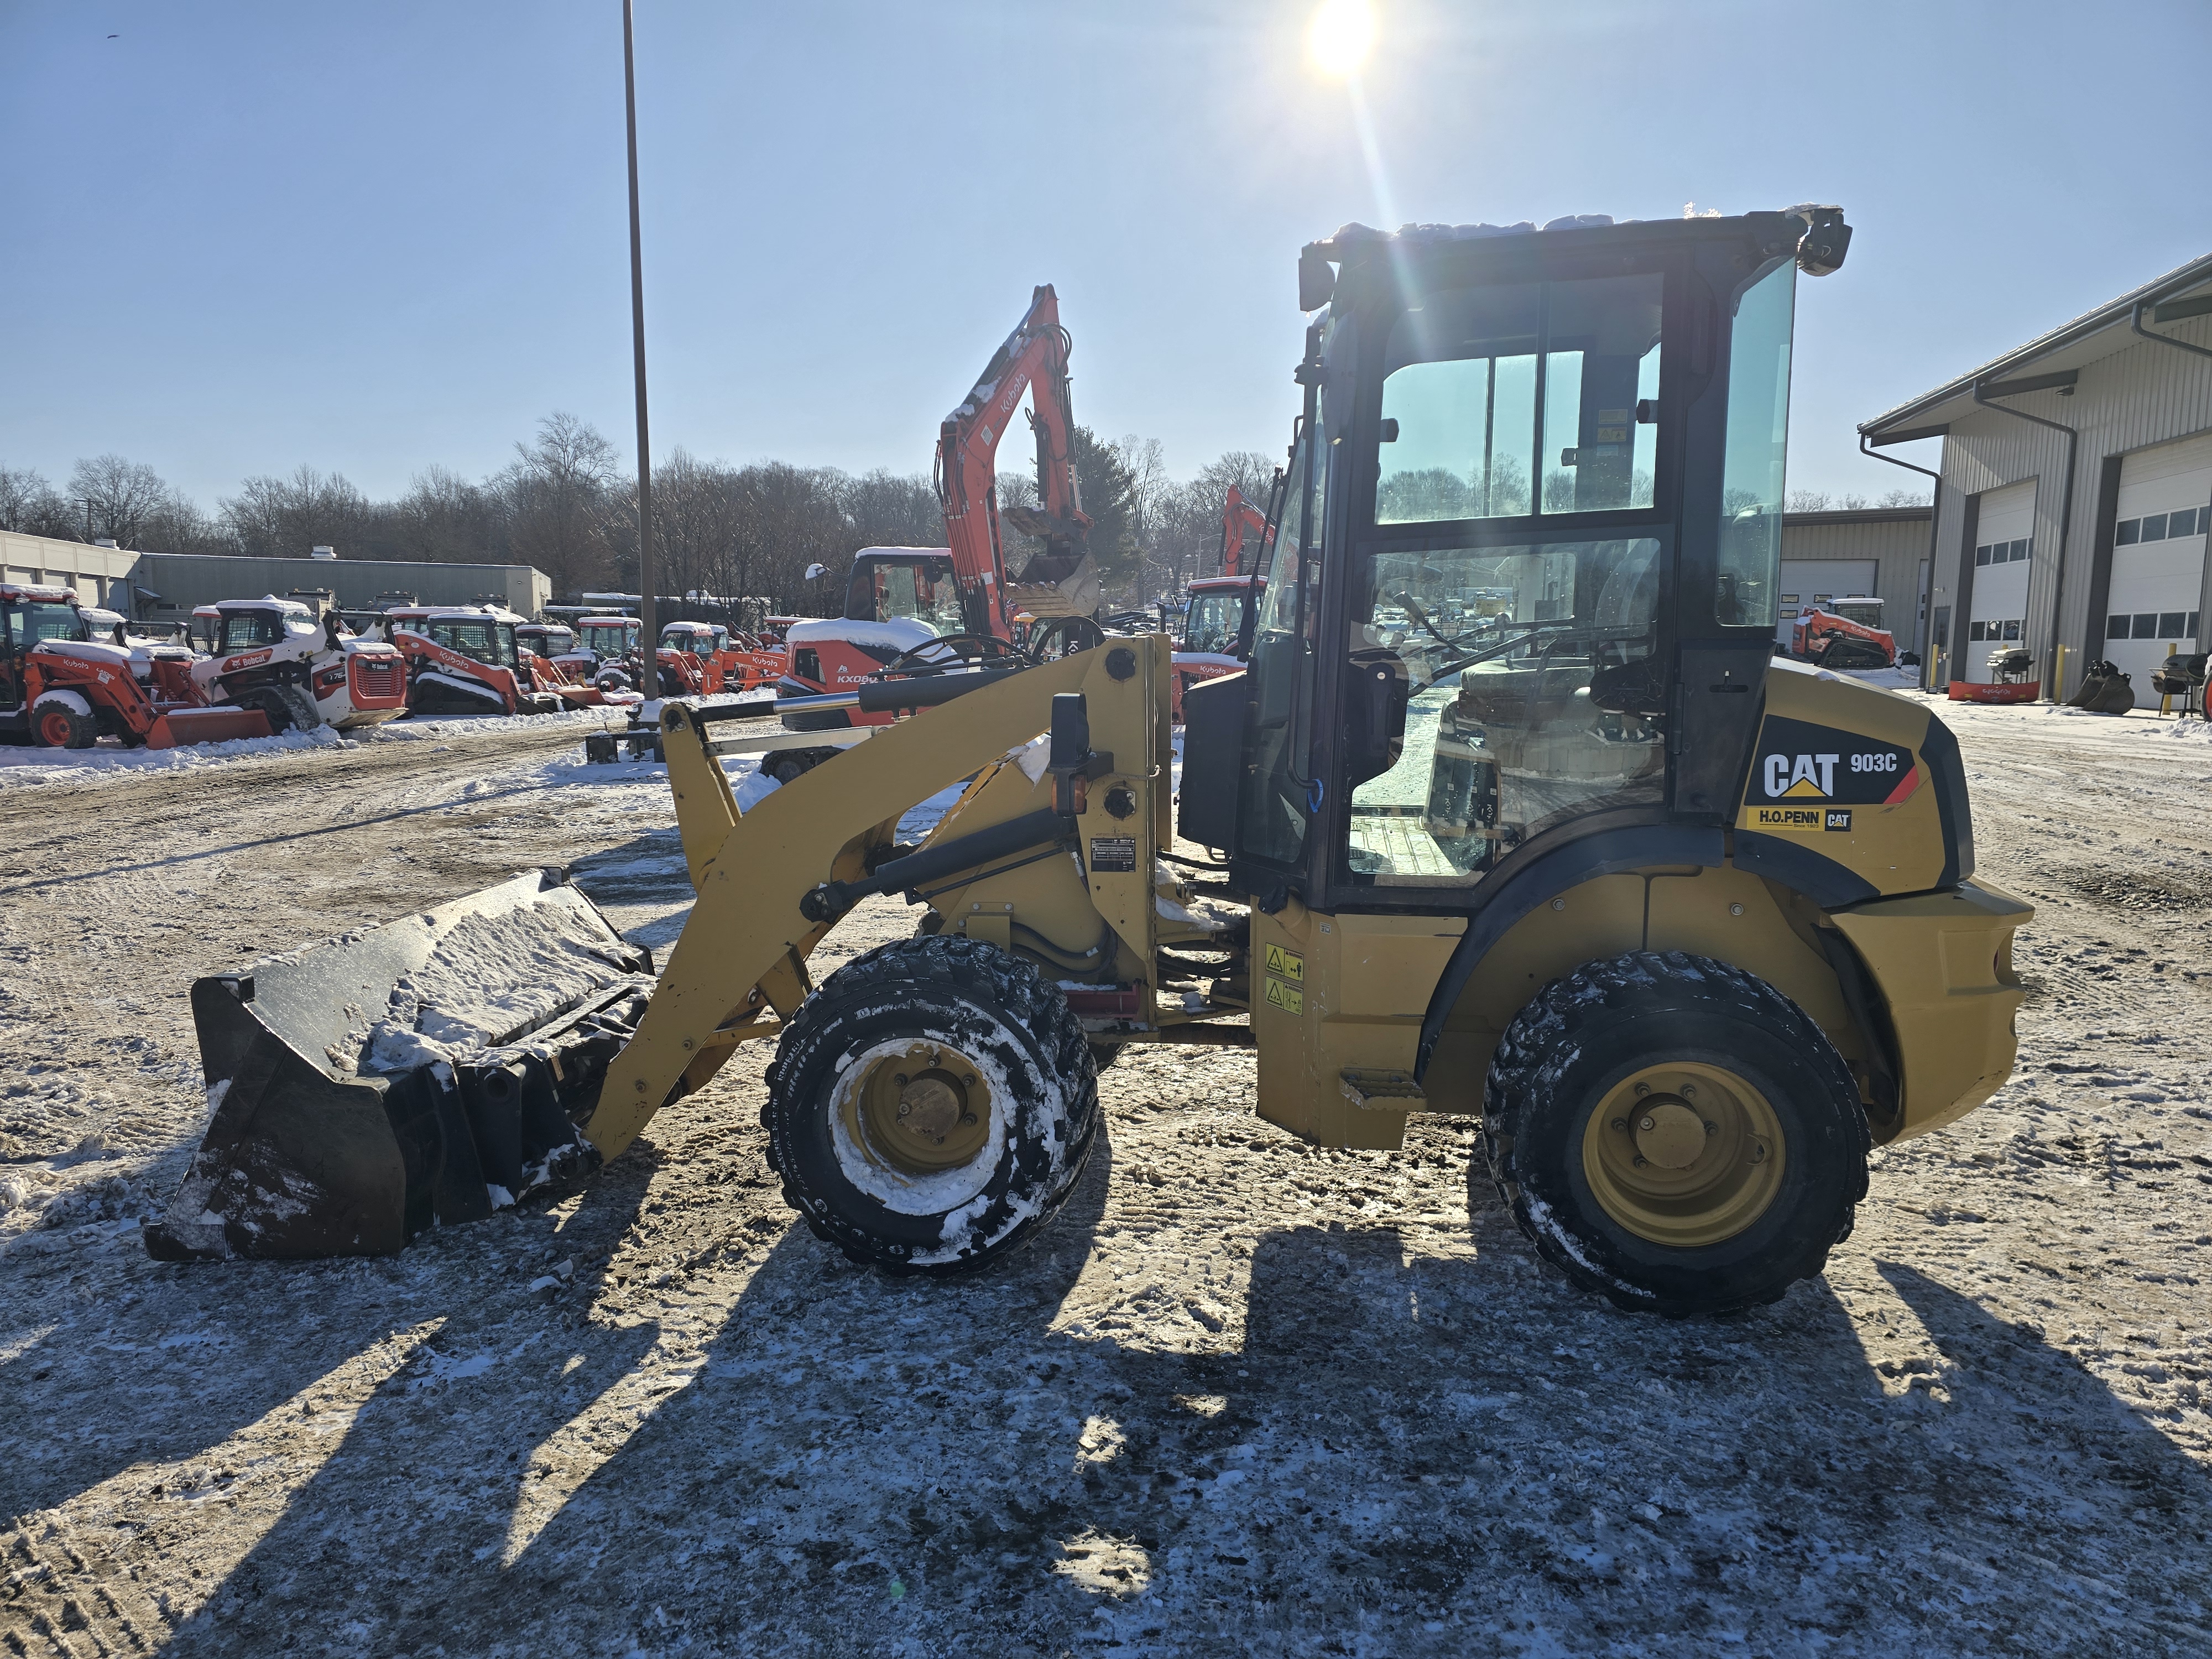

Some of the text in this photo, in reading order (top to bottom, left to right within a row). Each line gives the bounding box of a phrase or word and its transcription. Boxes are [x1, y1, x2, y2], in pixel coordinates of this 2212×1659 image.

[1000, 373, 1026, 413] Kubota
[1850, 625, 1871, 637] Kubota
[63, 659, 88, 669] Kubota
[242, 654, 266, 666] Bobcat
[439, 650, 469, 669] Kubota
[752, 656, 778, 667] Kubota
[1199, 665, 1226, 675] Kubota
[1851, 753, 1897, 772] 903C
[1764, 754, 1839, 797] CAT
[1760, 810, 1819, 824] H.O.PENN
[1827, 814, 1849, 827] CAT
[1288, 951, 1303, 960] WARNING
[1288, 985, 1302, 994] WARNING
